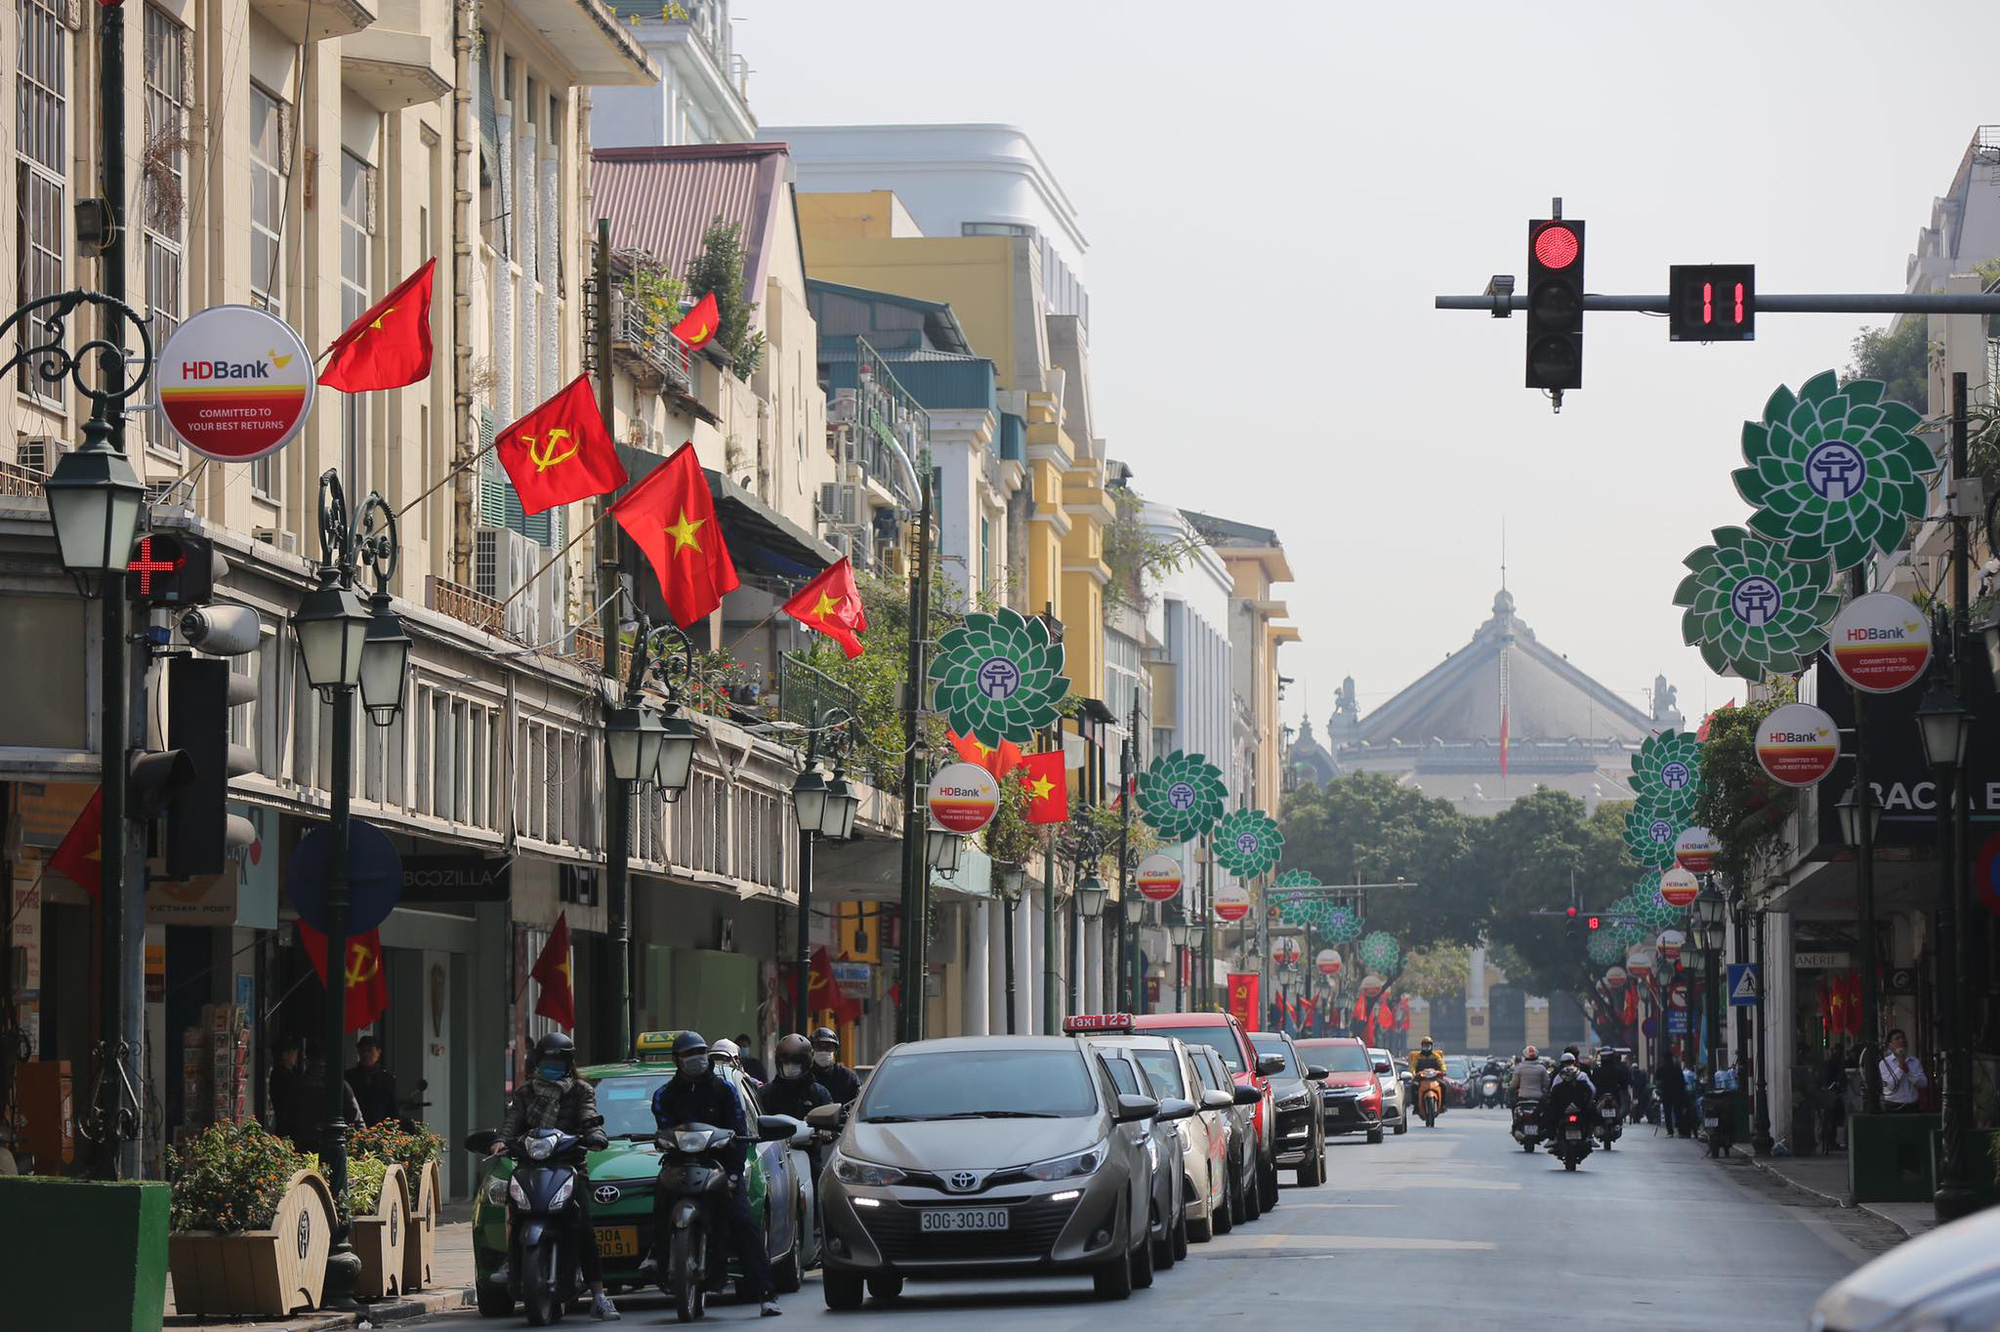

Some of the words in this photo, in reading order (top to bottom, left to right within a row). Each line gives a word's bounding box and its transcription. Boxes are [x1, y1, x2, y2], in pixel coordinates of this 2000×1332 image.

[1703, 282, 1743, 324] 11
[182, 360, 268, 380] HDBank
[199, 408, 257, 418] COMMITTED
[259, 407, 271, 416] TO
[188, 421, 214, 431] YOUR
[216, 421, 239, 431] BEST
[241, 420, 284, 430] RETURNS
[1847, 626, 1904, 641] HDBank
[1770, 732, 1817, 743] HDBank
[939, 787, 979, 797] HDBank
[1589, 917, 1598, 929] 18
[1068, 1015, 1096, 1027] Taxi
[1101, 1013, 1130, 1026] 123
[644, 1033, 676, 1043] TAX
[923, 1211, 1006, 1229] 30G-303.00
